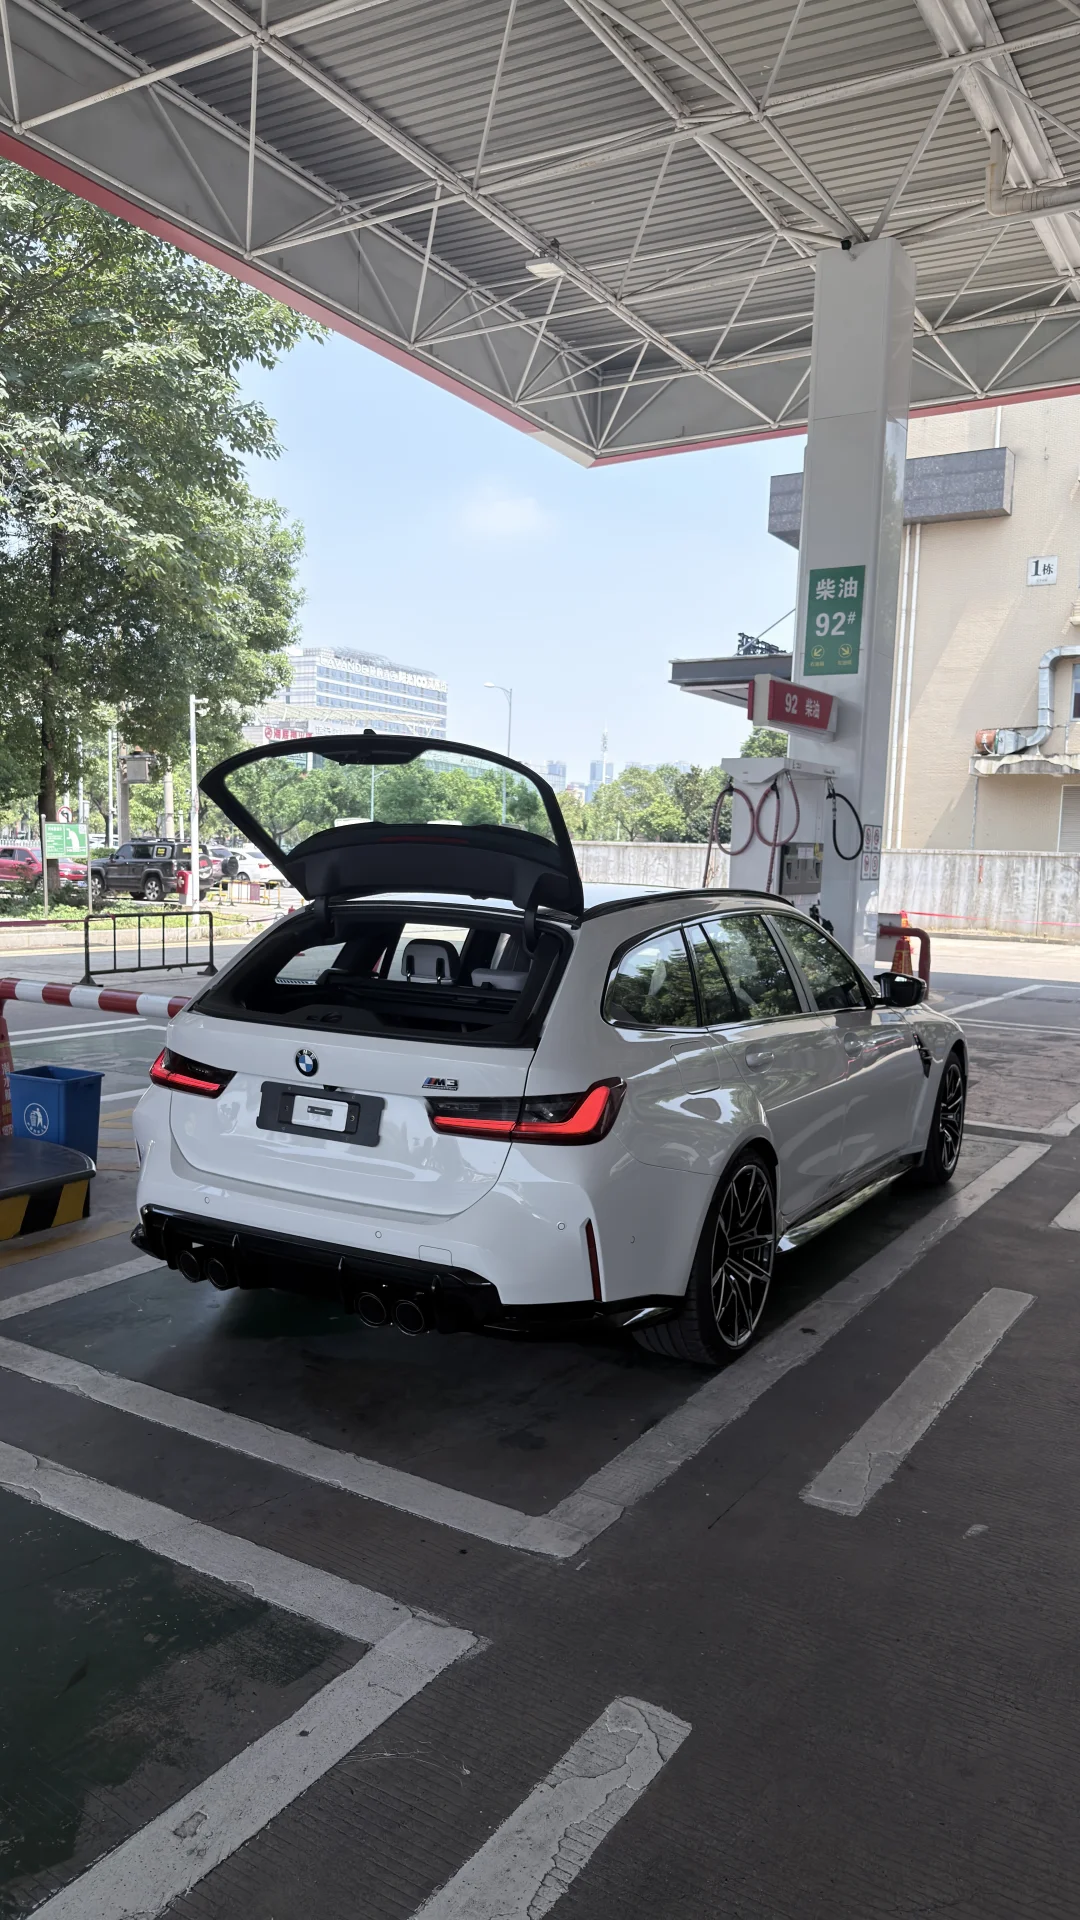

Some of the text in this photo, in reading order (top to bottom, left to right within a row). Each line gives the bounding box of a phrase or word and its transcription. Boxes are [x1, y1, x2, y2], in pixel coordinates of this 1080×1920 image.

[1031, 560, 1054, 576] 1栋
[815, 577, 858, 600] 柴油
[815, 611, 856, 636] 92#
[320, 655, 369, 674] LAVANDE
[785, 693, 820, 719] 92 柴油
[428, 1077, 459, 1087] M3
